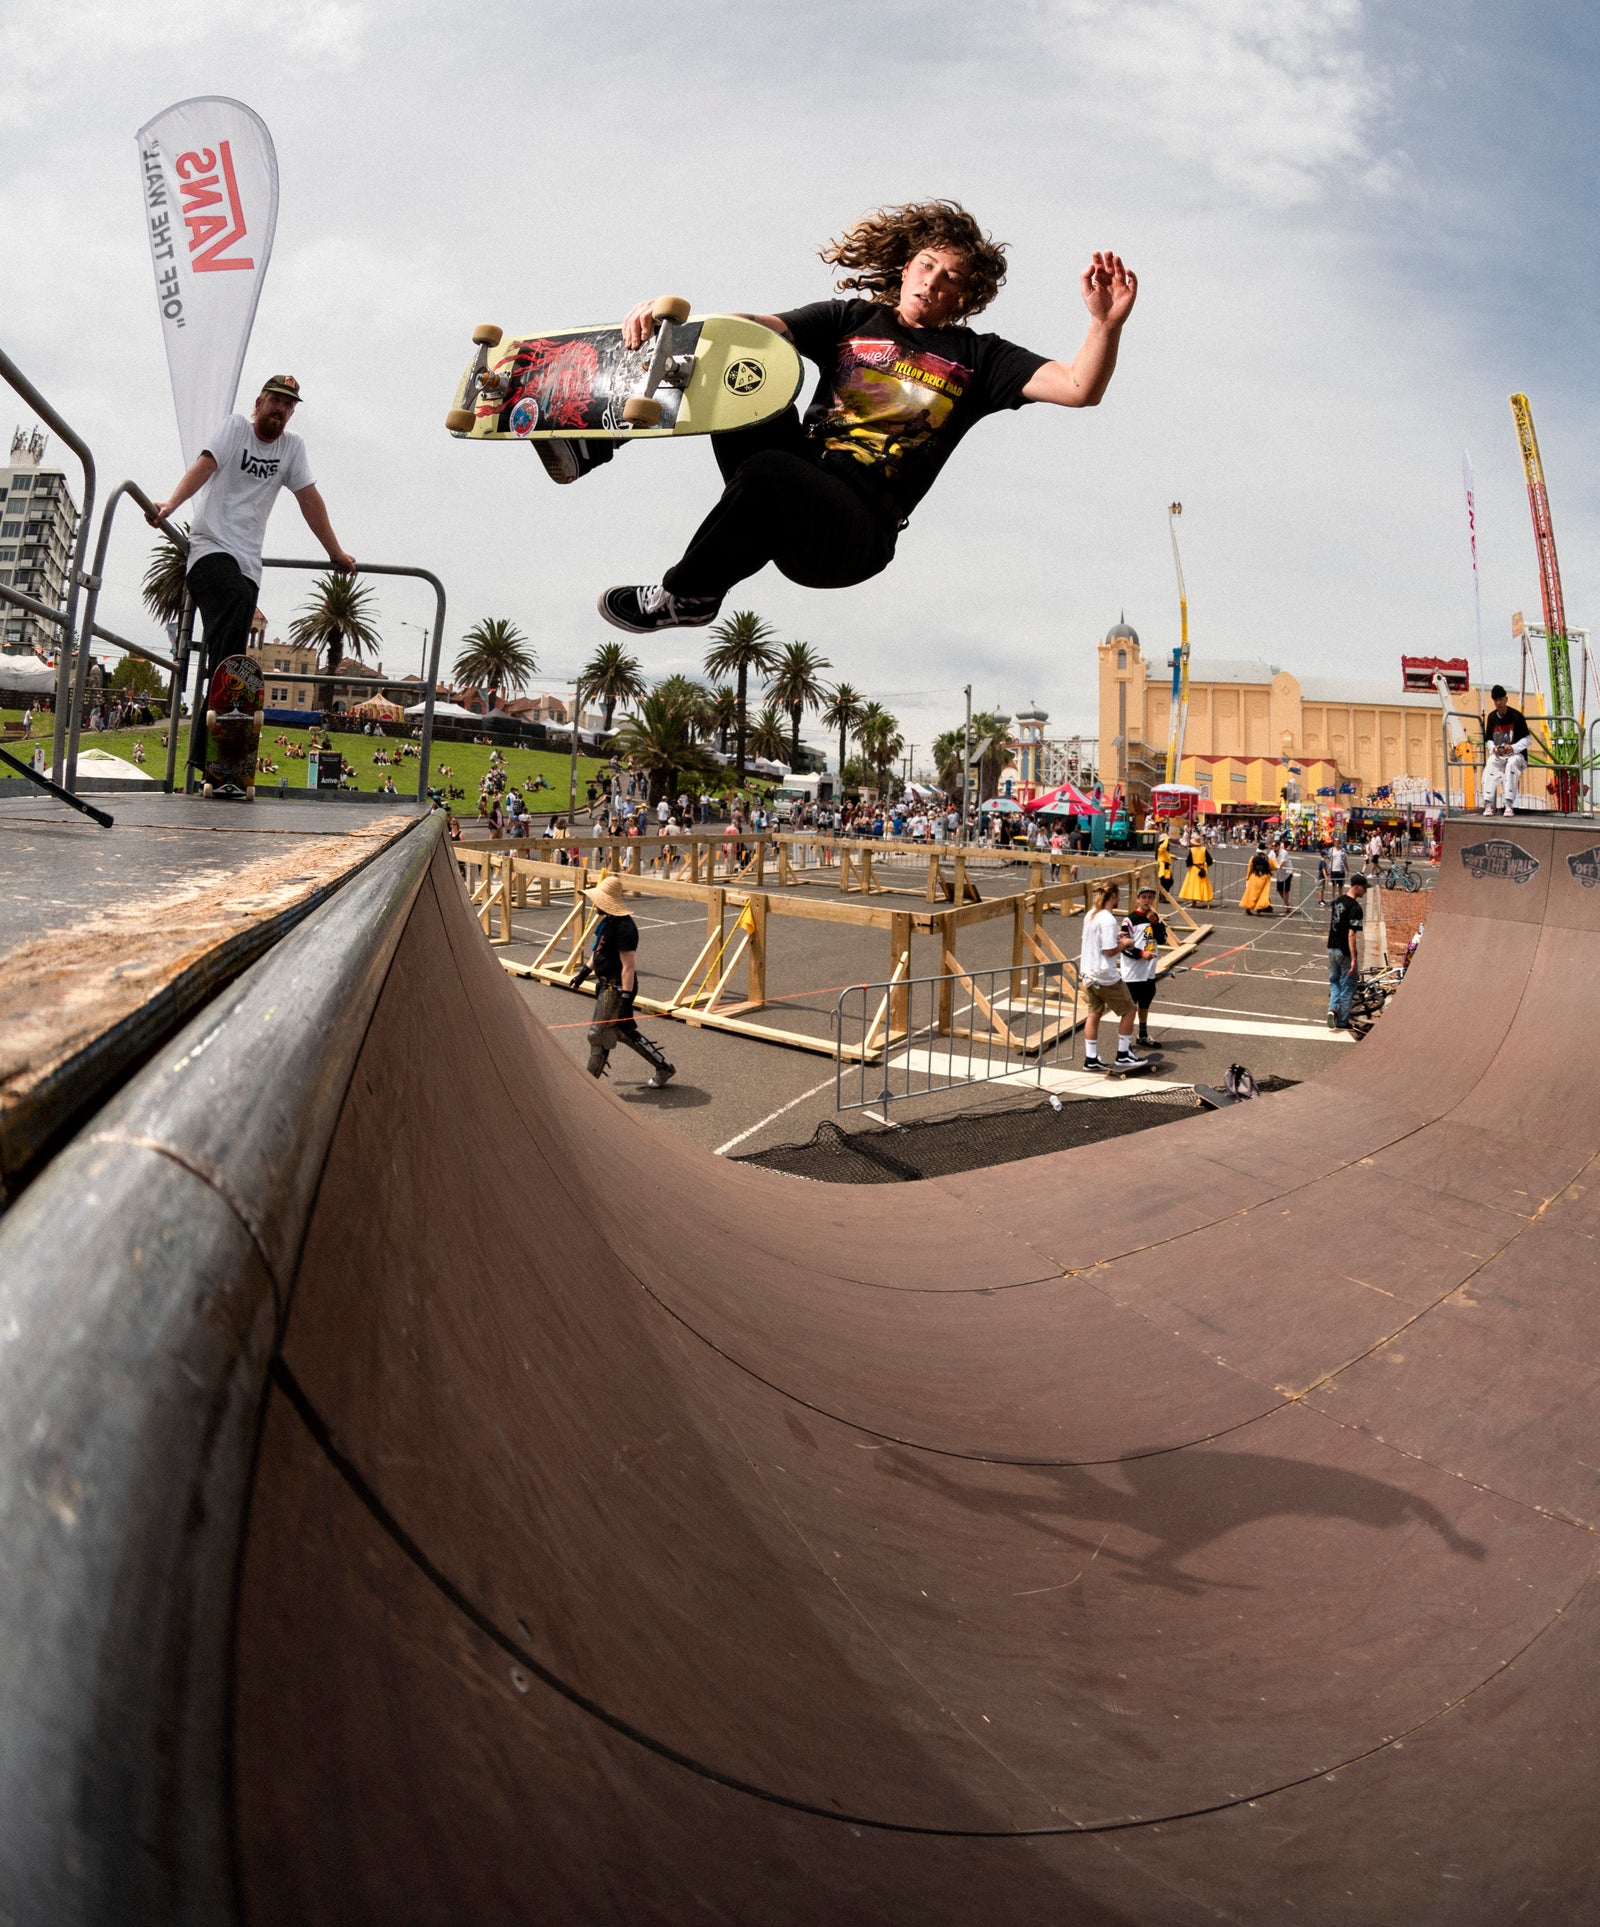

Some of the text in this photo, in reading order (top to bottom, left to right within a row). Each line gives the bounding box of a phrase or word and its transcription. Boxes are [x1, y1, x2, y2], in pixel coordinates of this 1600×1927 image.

[893, 361, 963, 396] YELLOW BRICK ROAD
[240, 448, 280, 479] VANS
[1361, 810, 1377, 818] POP
[1485, 843, 1513, 858] VANS
[1486, 857, 1507, 875] THE
